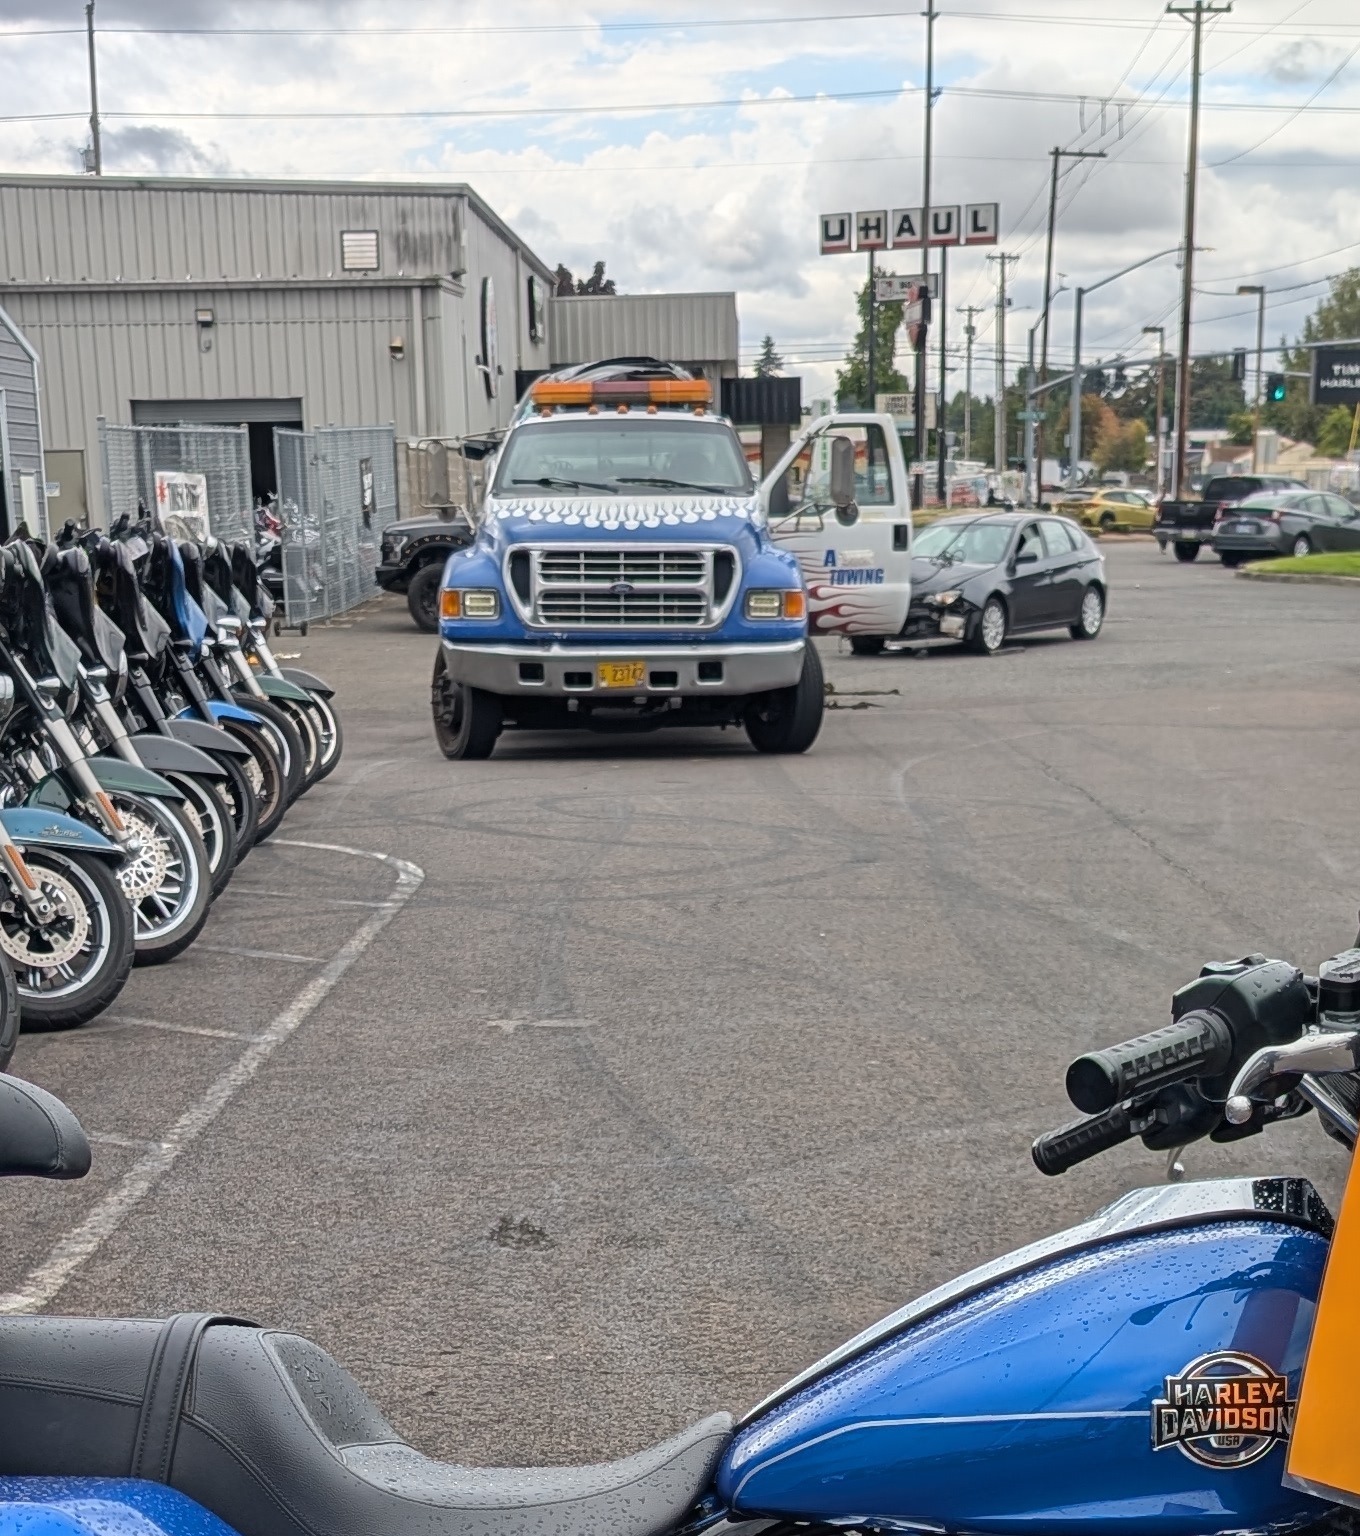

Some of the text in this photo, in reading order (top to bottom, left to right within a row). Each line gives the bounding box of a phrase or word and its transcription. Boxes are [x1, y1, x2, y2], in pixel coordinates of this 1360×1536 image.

[824, 209, 988, 242] UHAUL
[824, 549, 837, 567] A
[830, 568, 885, 586] TOWING
[1174, 1382, 1284, 1406] HARLEY-
[1160, 1406, 1295, 1442] DAVIDSON
[1217, 1435, 1240, 1446] USA
